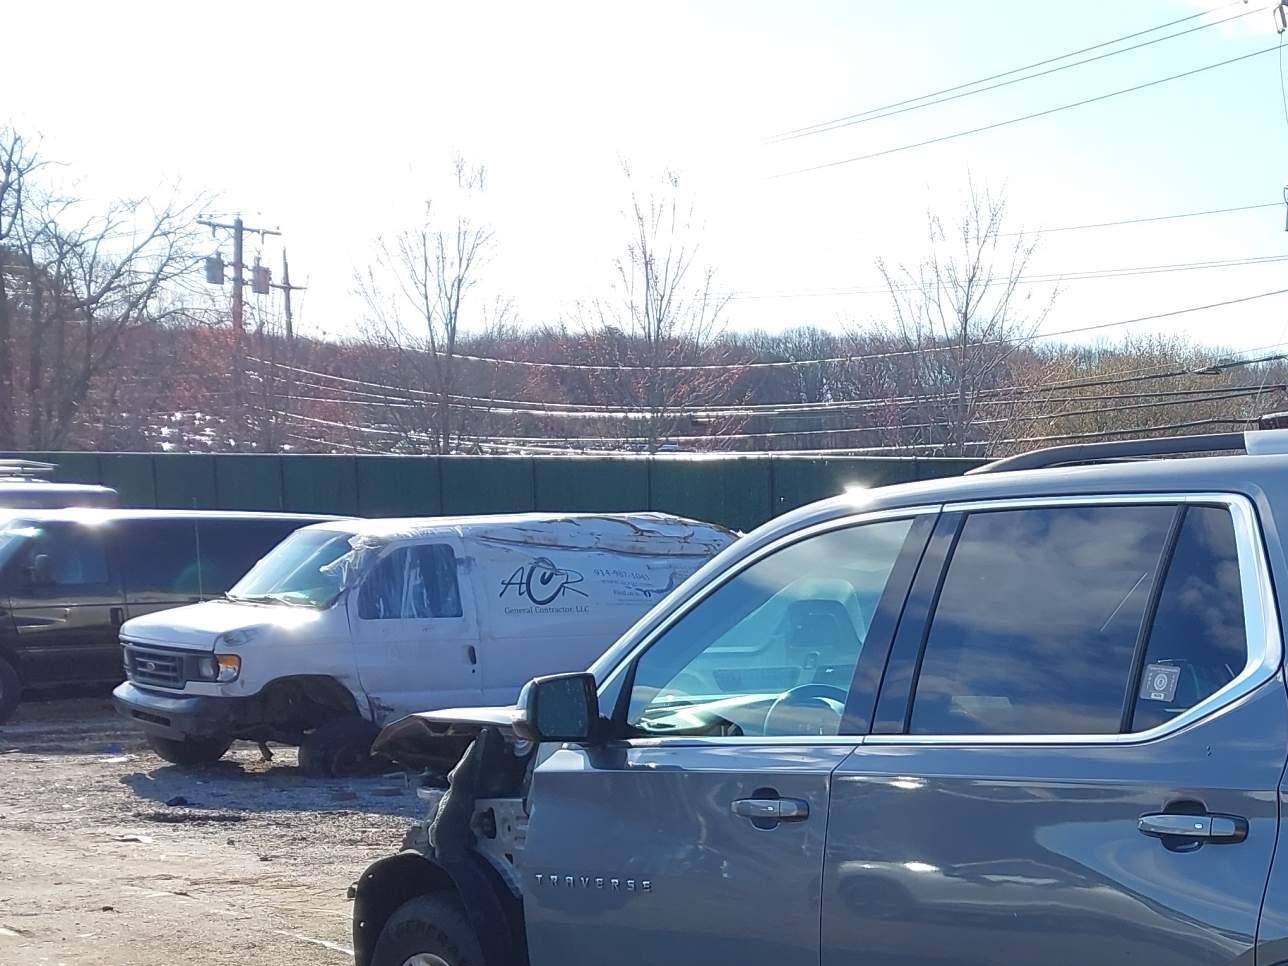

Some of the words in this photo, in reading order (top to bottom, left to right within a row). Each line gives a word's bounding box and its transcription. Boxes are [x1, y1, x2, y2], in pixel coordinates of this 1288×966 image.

[504, 606, 533, 615] General
[576, 605, 590, 614] LLC
[535, 874, 652, 892] TRAVERSE
